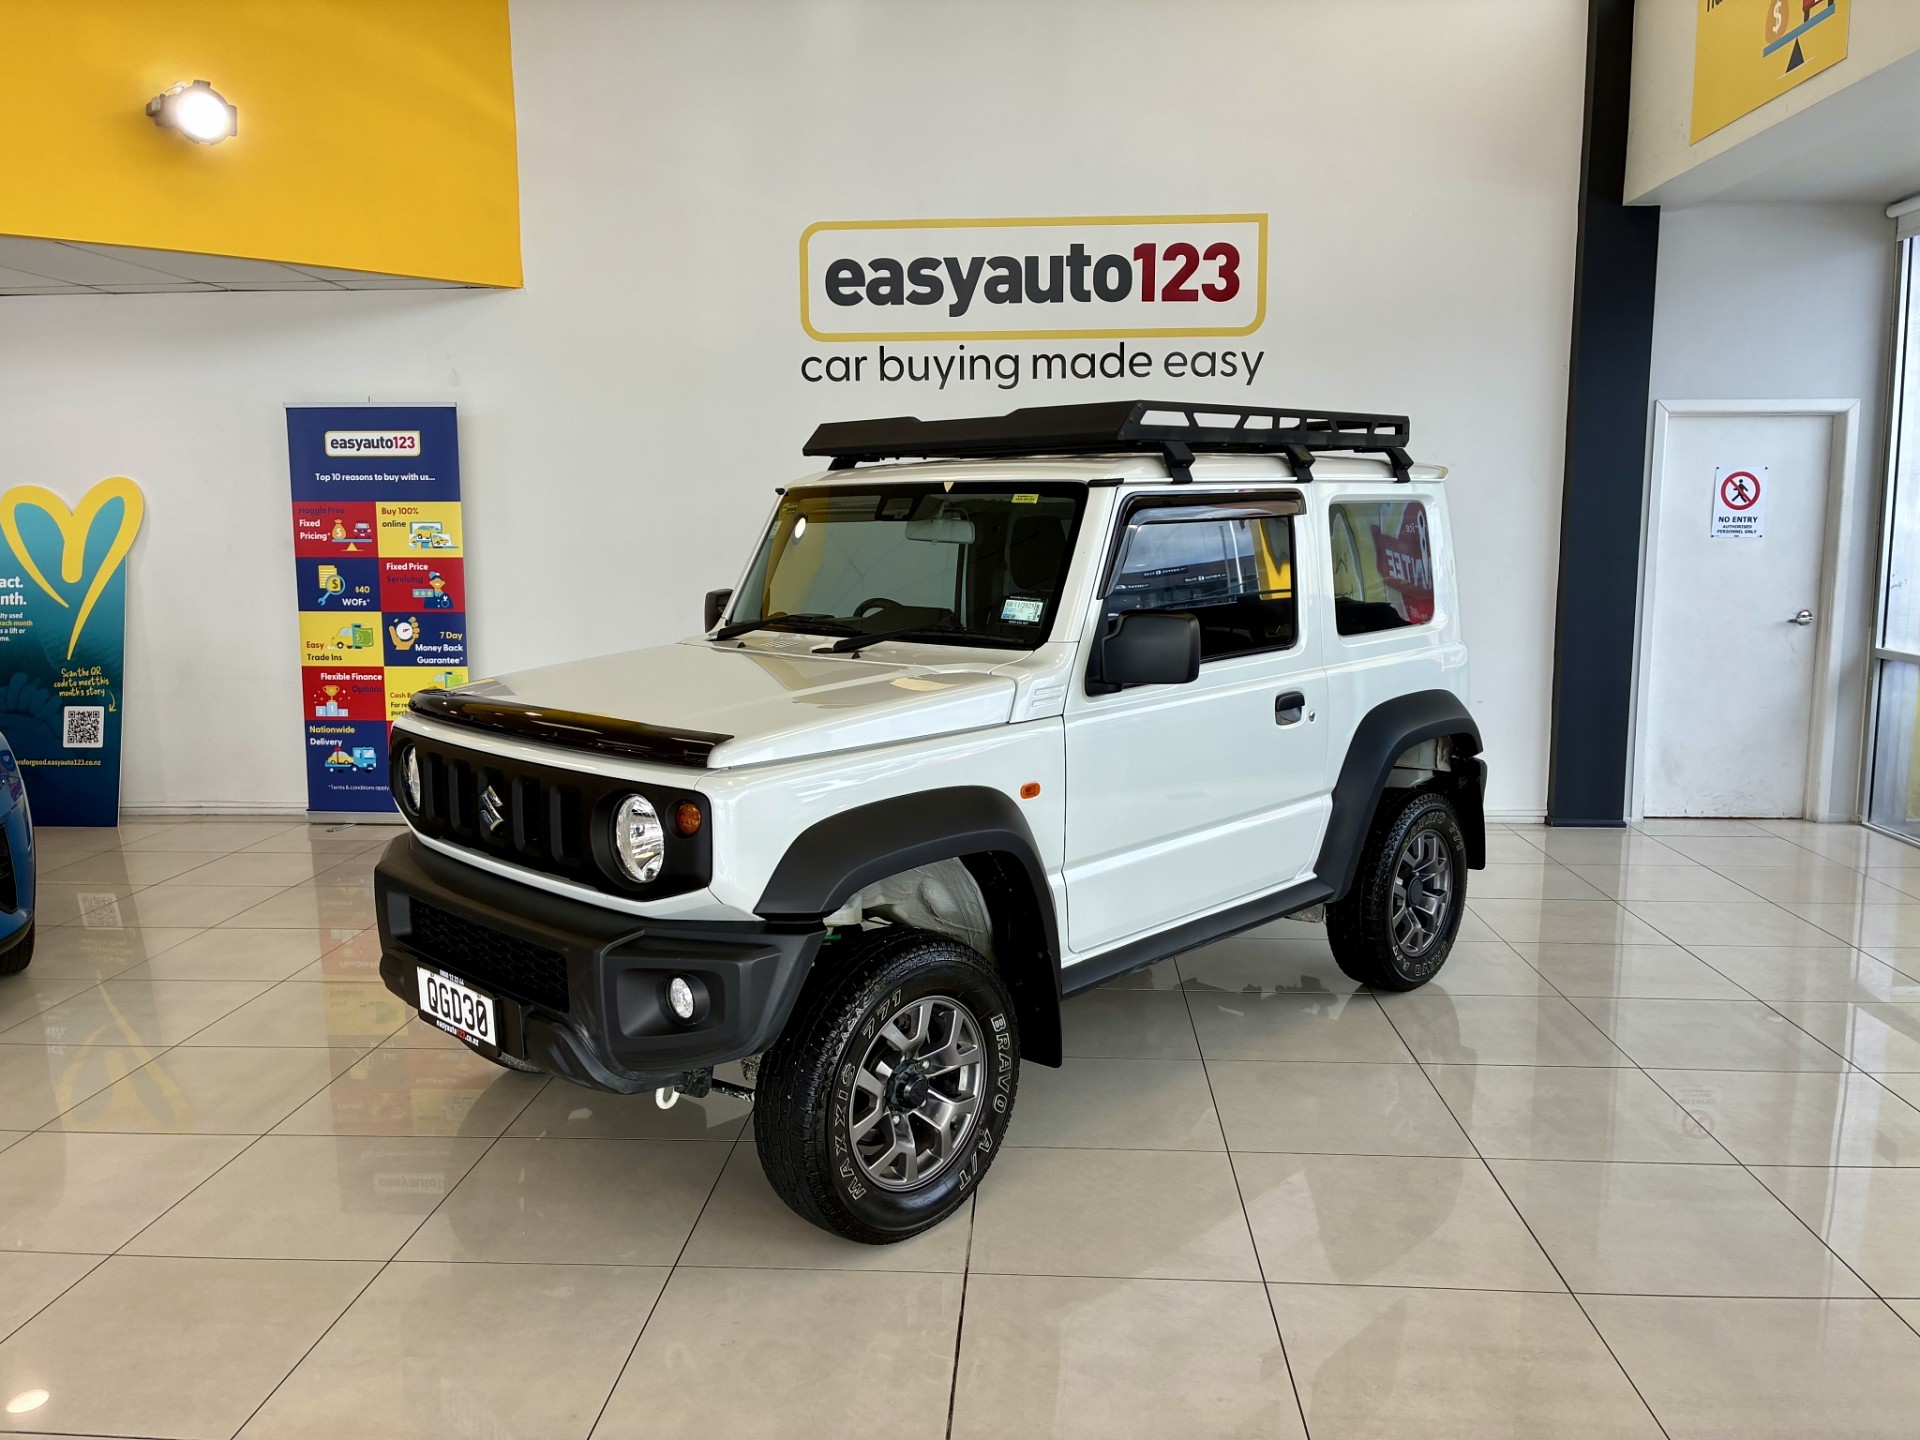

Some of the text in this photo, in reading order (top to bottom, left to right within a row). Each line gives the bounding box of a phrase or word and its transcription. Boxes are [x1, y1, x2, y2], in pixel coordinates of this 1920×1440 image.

[825, 242, 1241, 317] easyauto123
[801, 342, 1265, 390] car buying made easy
[330, 436, 416, 452] easyauto123
[315, 473, 331, 482] Top
[332, 473, 341, 481] 10
[374, 473, 383, 481] to
[384, 473, 399, 482] buy
[400, 473, 419, 481] with
[298, 507, 326, 515] Haggle
[381, 507, 419, 516] Buy 100%
[381, 519, 407, 527] online
[386, 576, 424, 585] Servicing
[446, 632, 463, 640] Day
[306, 641, 325, 650] Easy
[415, 644, 442, 652] Money
[307, 653, 343, 661] Trade Ins
[61, 666, 102, 677] Scan the QR
[68, 678, 77, 686] to
[78, 676, 96, 685] meet
[95, 675, 110, 685] this
[86, 686, 105, 697] story
[352, 685, 383, 693] Options
[310, 738, 343, 747] Delivery
[427, 977, 489, 1037] QGD30
[990, 1012, 1013, 1114] BRAVO
[834, 1062, 867, 1200] MAXXIS
